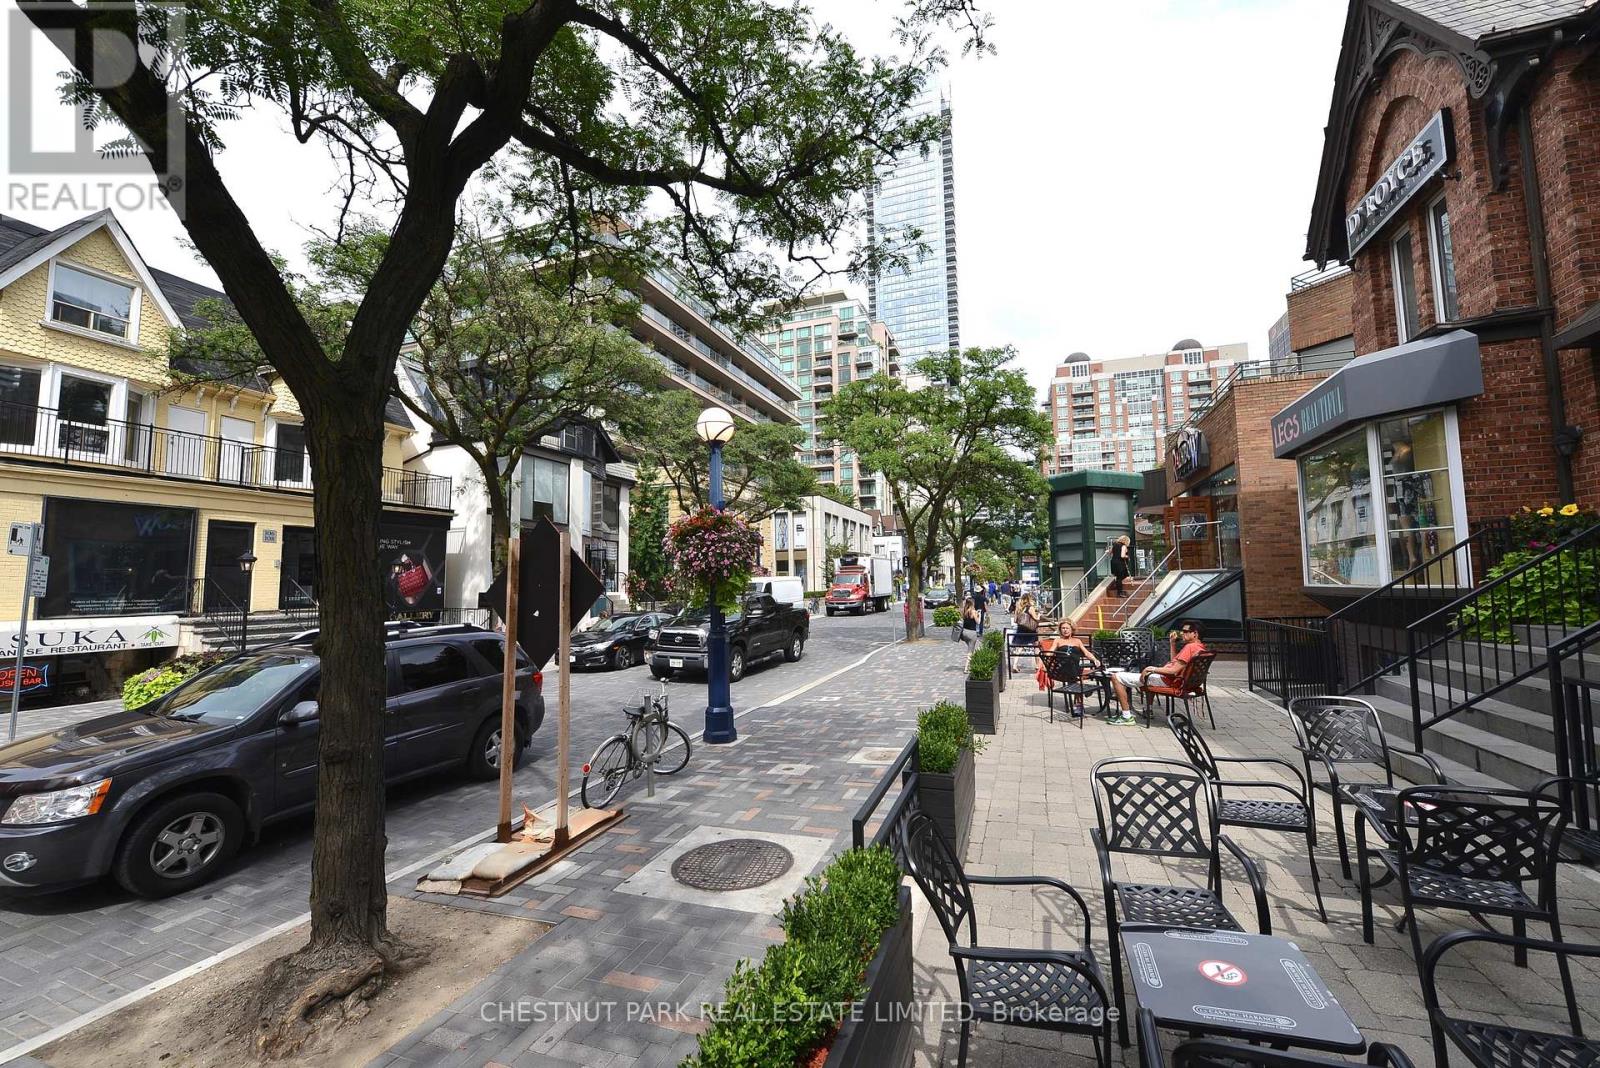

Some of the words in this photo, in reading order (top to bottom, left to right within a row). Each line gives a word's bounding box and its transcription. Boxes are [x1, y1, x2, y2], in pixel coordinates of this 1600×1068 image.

[1273, 414, 1300, 449] LEGS
[0, 628, 128, 649] SUKA
[50, 642, 129, 654] RESTAURANT
[23, 677, 42, 686] BAR
